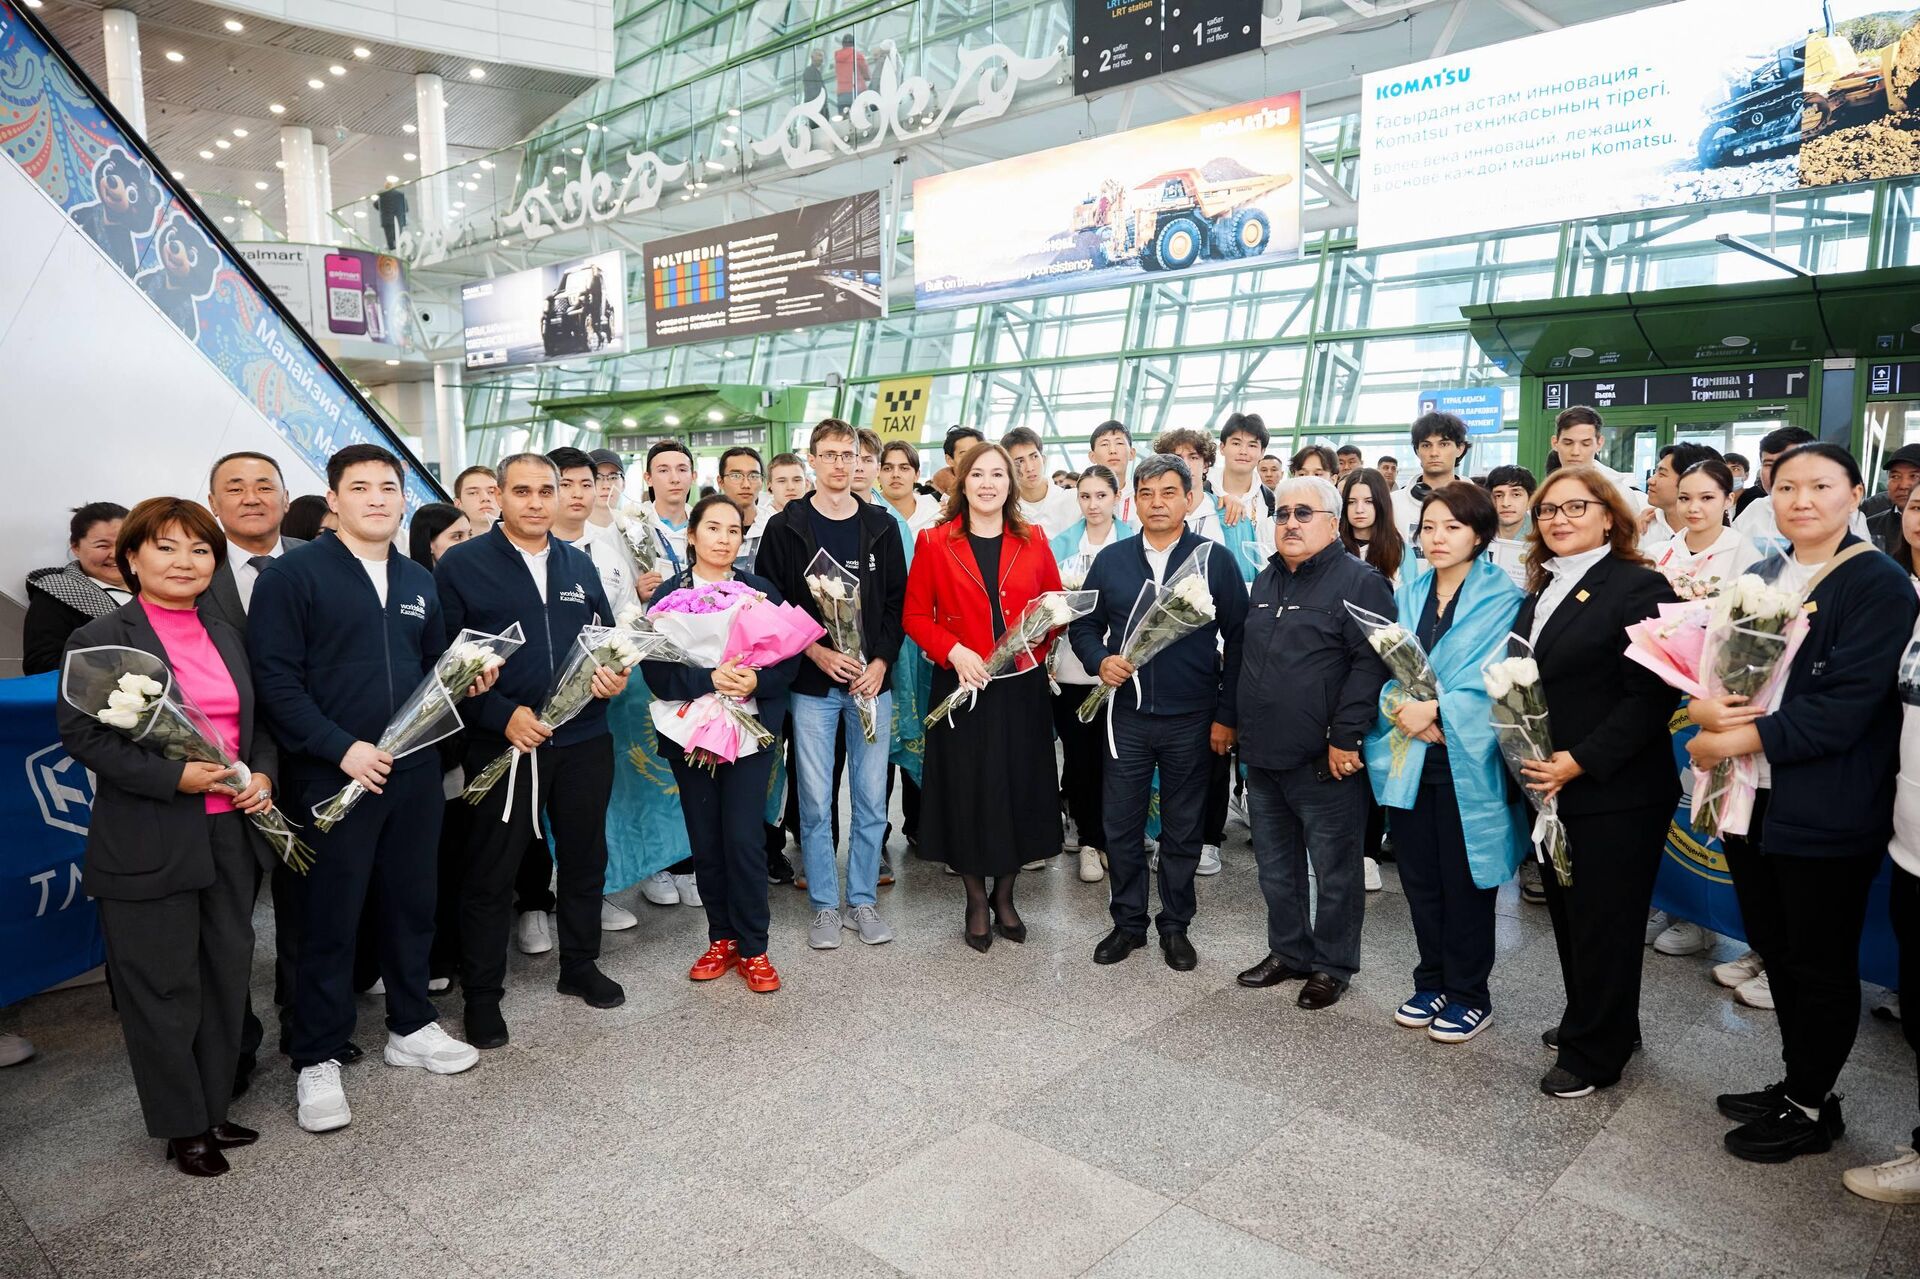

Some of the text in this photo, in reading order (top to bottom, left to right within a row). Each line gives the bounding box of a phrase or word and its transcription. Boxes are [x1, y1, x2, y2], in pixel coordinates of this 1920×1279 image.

[1112, 7, 1127, 18] LRT
[1128, 1, 1153, 13] station
[1193, 22, 1203, 46] 1
[1215, 32, 1230, 41] floor
[1099, 49, 1112, 73] 2
[1120, 58, 1133, 67] floor
[1376, 67, 1471, 101] KOMATSU
[1376, 103, 1460, 130] Ғасырдан
[1465, 90, 1521, 113] астам
[1527, 66, 1639, 101] инновация
[1375, 80, 1671, 150] Komatsu техникасының тірегі.
[1423, 152, 1460, 168] века
[1565, 117, 1653, 142] лежащих
[1385, 174, 1440, 191] основе
[1512, 149, 1585, 170] машины
[1591, 132, 1677, 156] Komatsu.
[653, 243, 725, 270] POLYMEDIA
[1034, 258, 1094, 277] consistency.
[255, 317, 342, 422] Малайзия
[1691, 373, 1754, 388] Терминал 1
[1691, 387, 1754, 401] Терминал 1
[882, 414, 917, 433] TAXI
